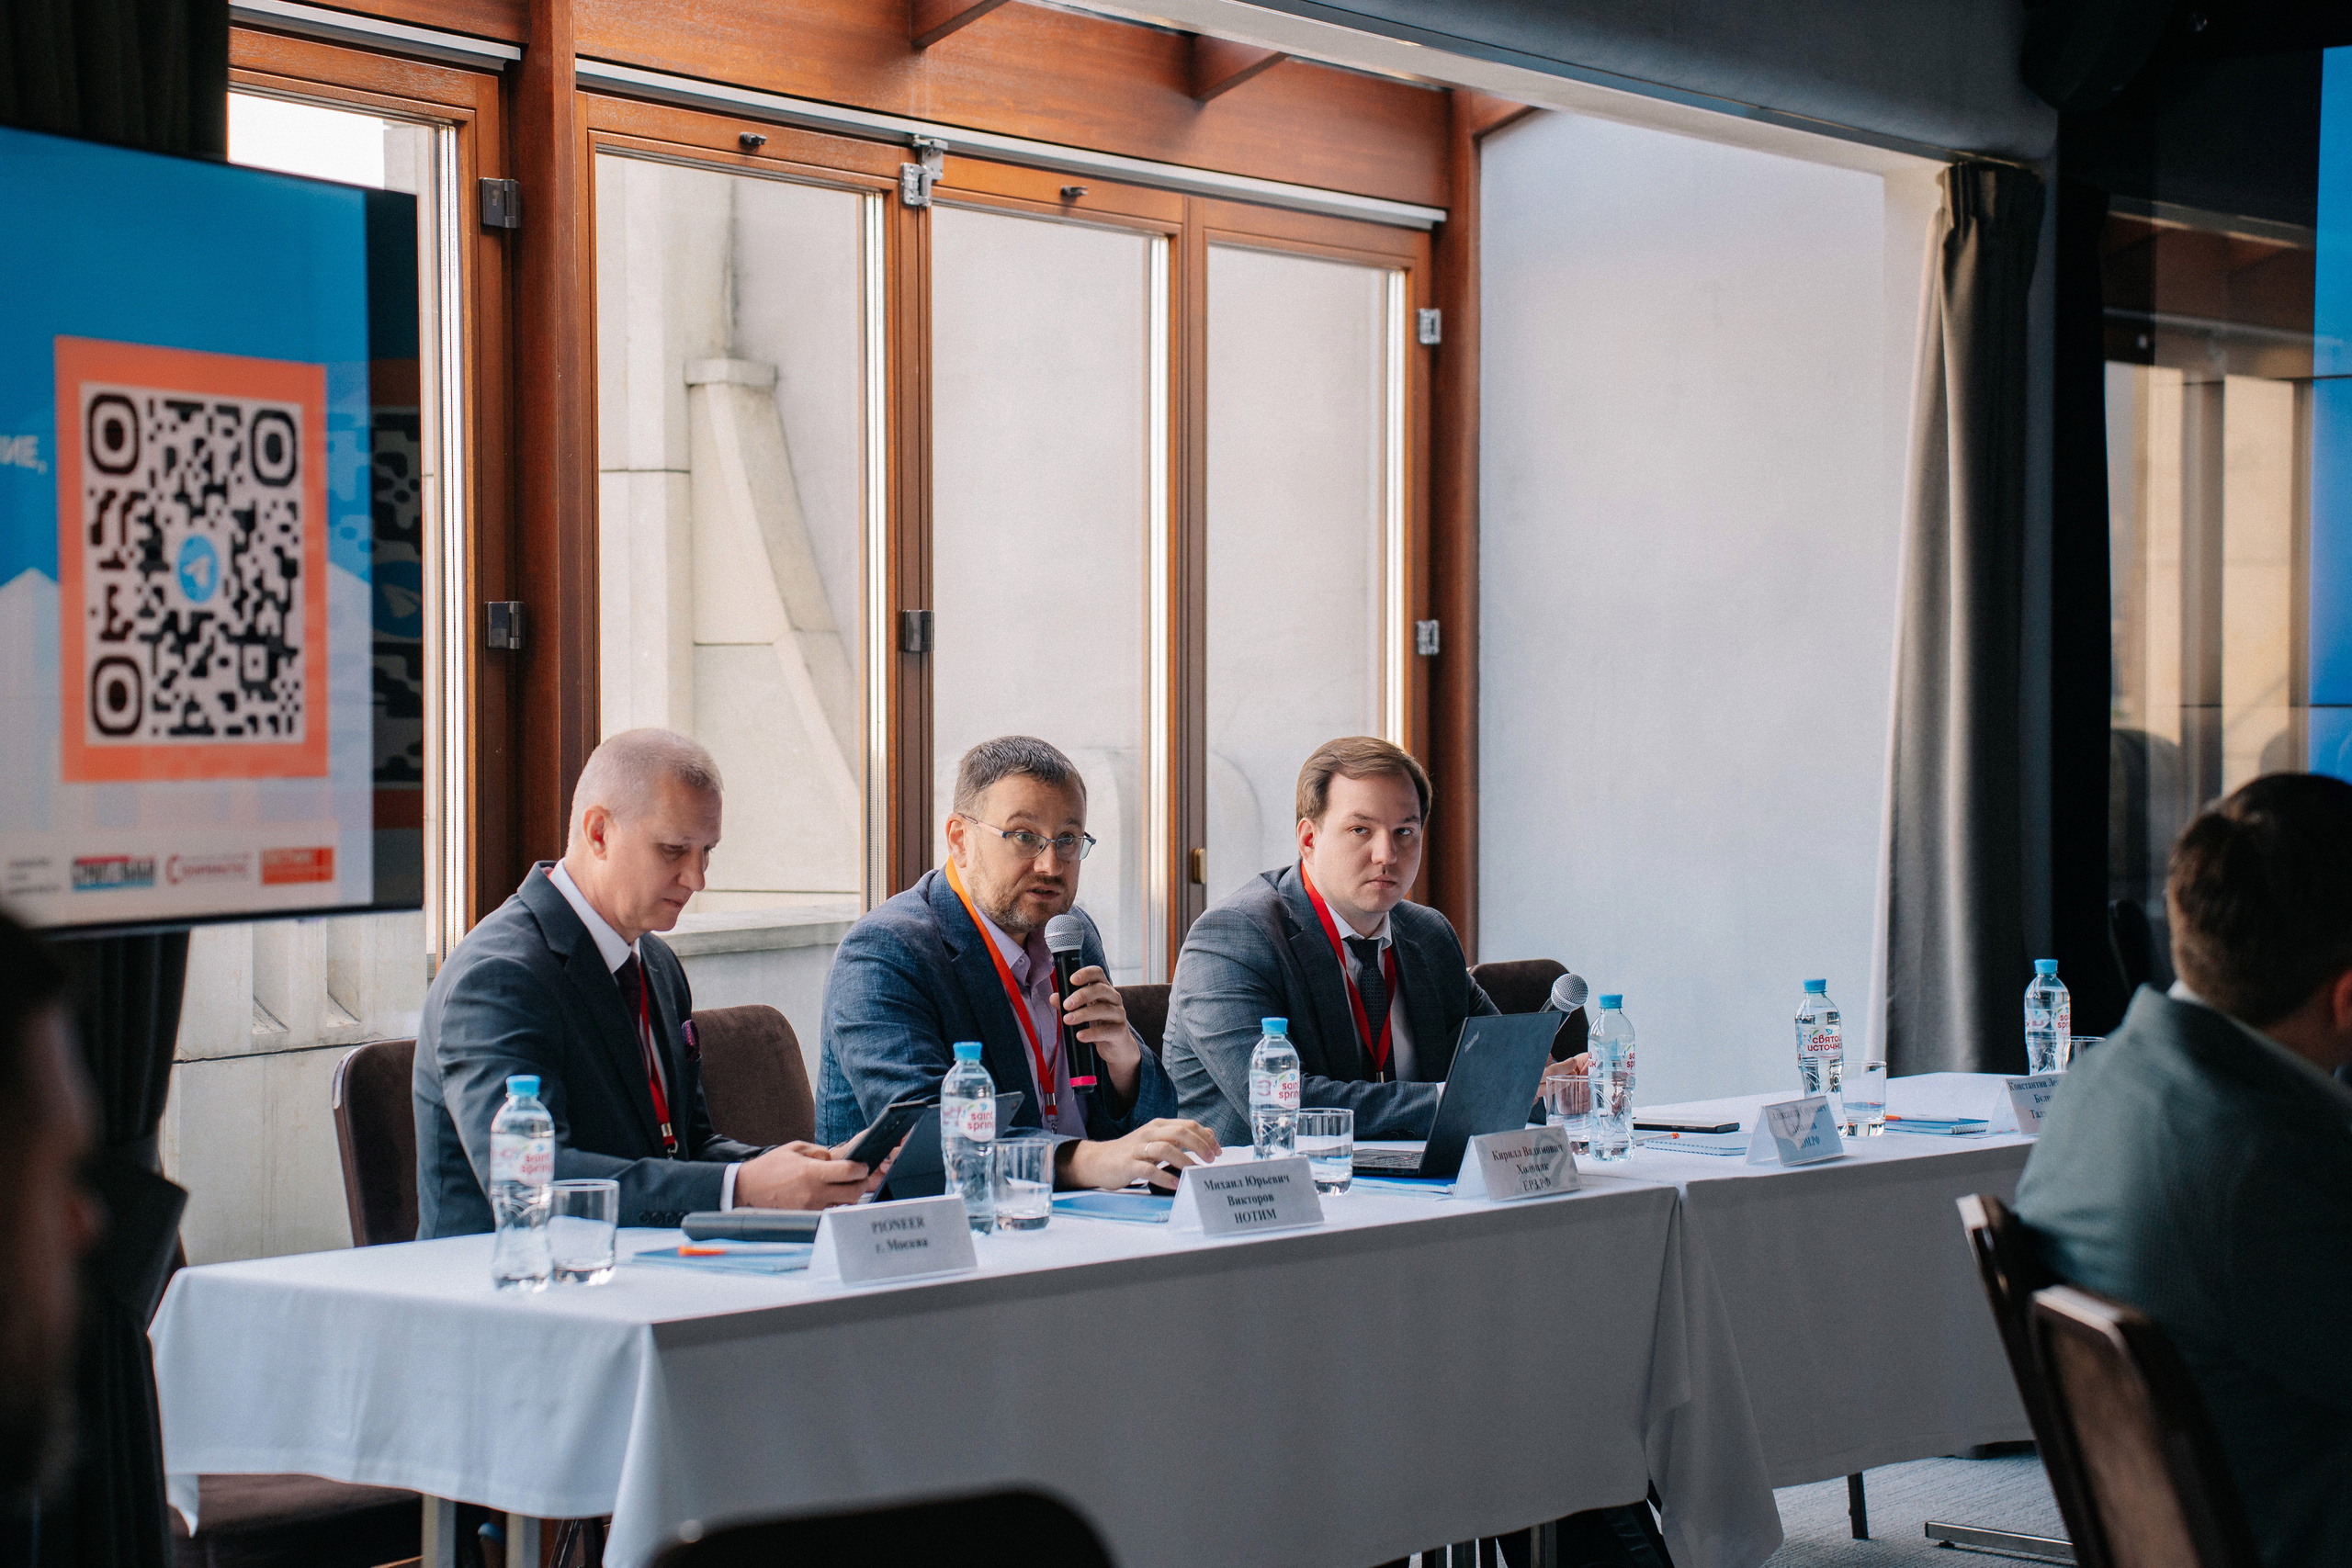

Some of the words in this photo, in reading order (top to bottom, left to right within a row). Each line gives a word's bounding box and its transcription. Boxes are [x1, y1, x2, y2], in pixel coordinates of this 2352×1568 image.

[2008, 1081, 2048, 1091] Константин
[1279, 1090, 1299, 1100] sprin
[1491, 1149, 1522, 1162] Кирилл
[1522, 1144, 1564, 1156] Вадимович
[1204, 1179, 1243, 1191] Михаил
[1244, 1173, 1290, 1189] Юрьевич
[1227, 1194, 1275, 1206] Викторов
[1235, 1209, 1277, 1224] НОТИМ
[871, 1215, 925, 1234] PIONEER
[887, 1238, 929, 1252] Москва
